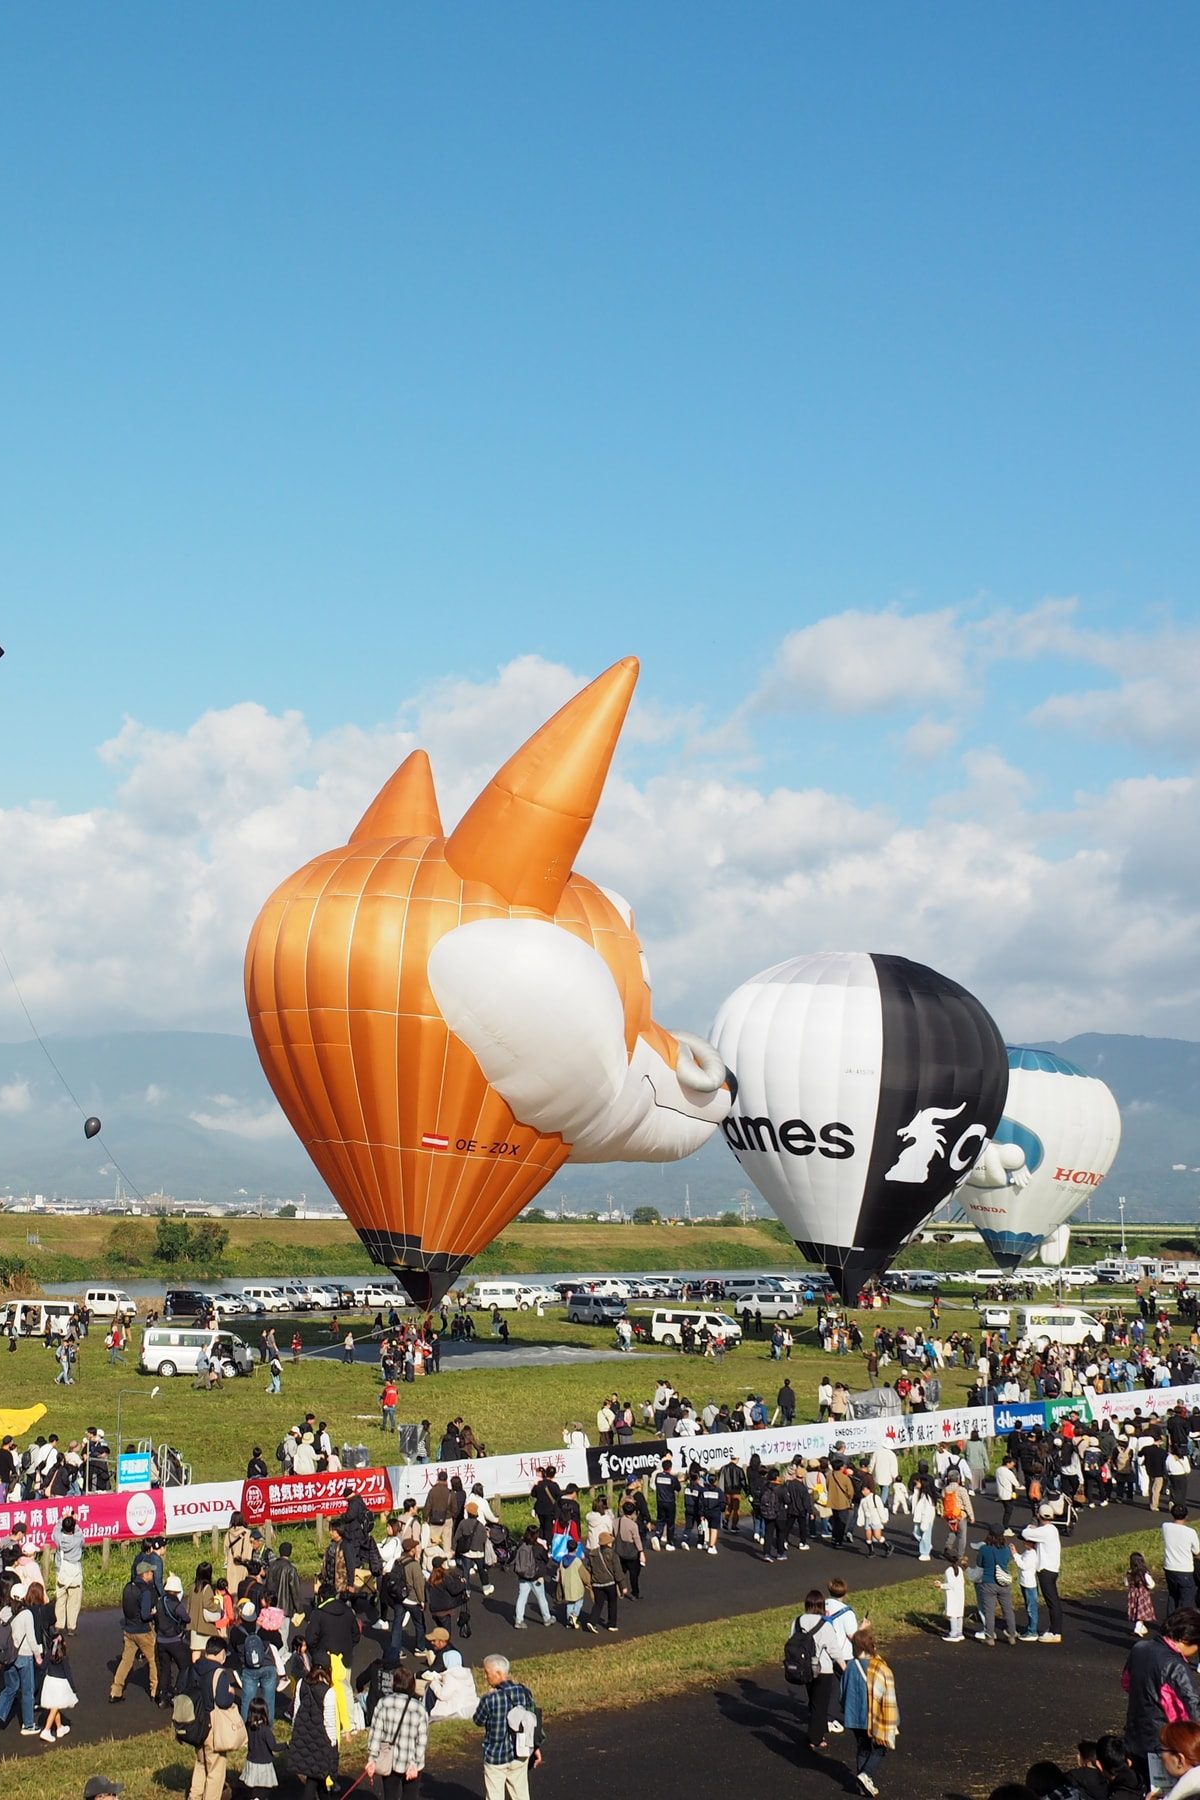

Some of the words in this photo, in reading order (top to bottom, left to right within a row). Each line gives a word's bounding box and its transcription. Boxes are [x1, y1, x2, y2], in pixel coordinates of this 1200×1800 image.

[722, 1116, 855, 1161] ames
[969, 1204, 1007, 1214] HONDA
[1032, 1316, 1047, 1326] 96
[898, 1425, 934, 1443] 佐賀銀行
[609, 1452, 661, 1474] Cygames
[689, 1446, 734, 1464] Cygames
[268, 1475, 385, 1503] 熱気球ホンダグランプリ
[173, 1500, 236, 1516] HONDA
[76, 1521, 119, 1538] ailand
